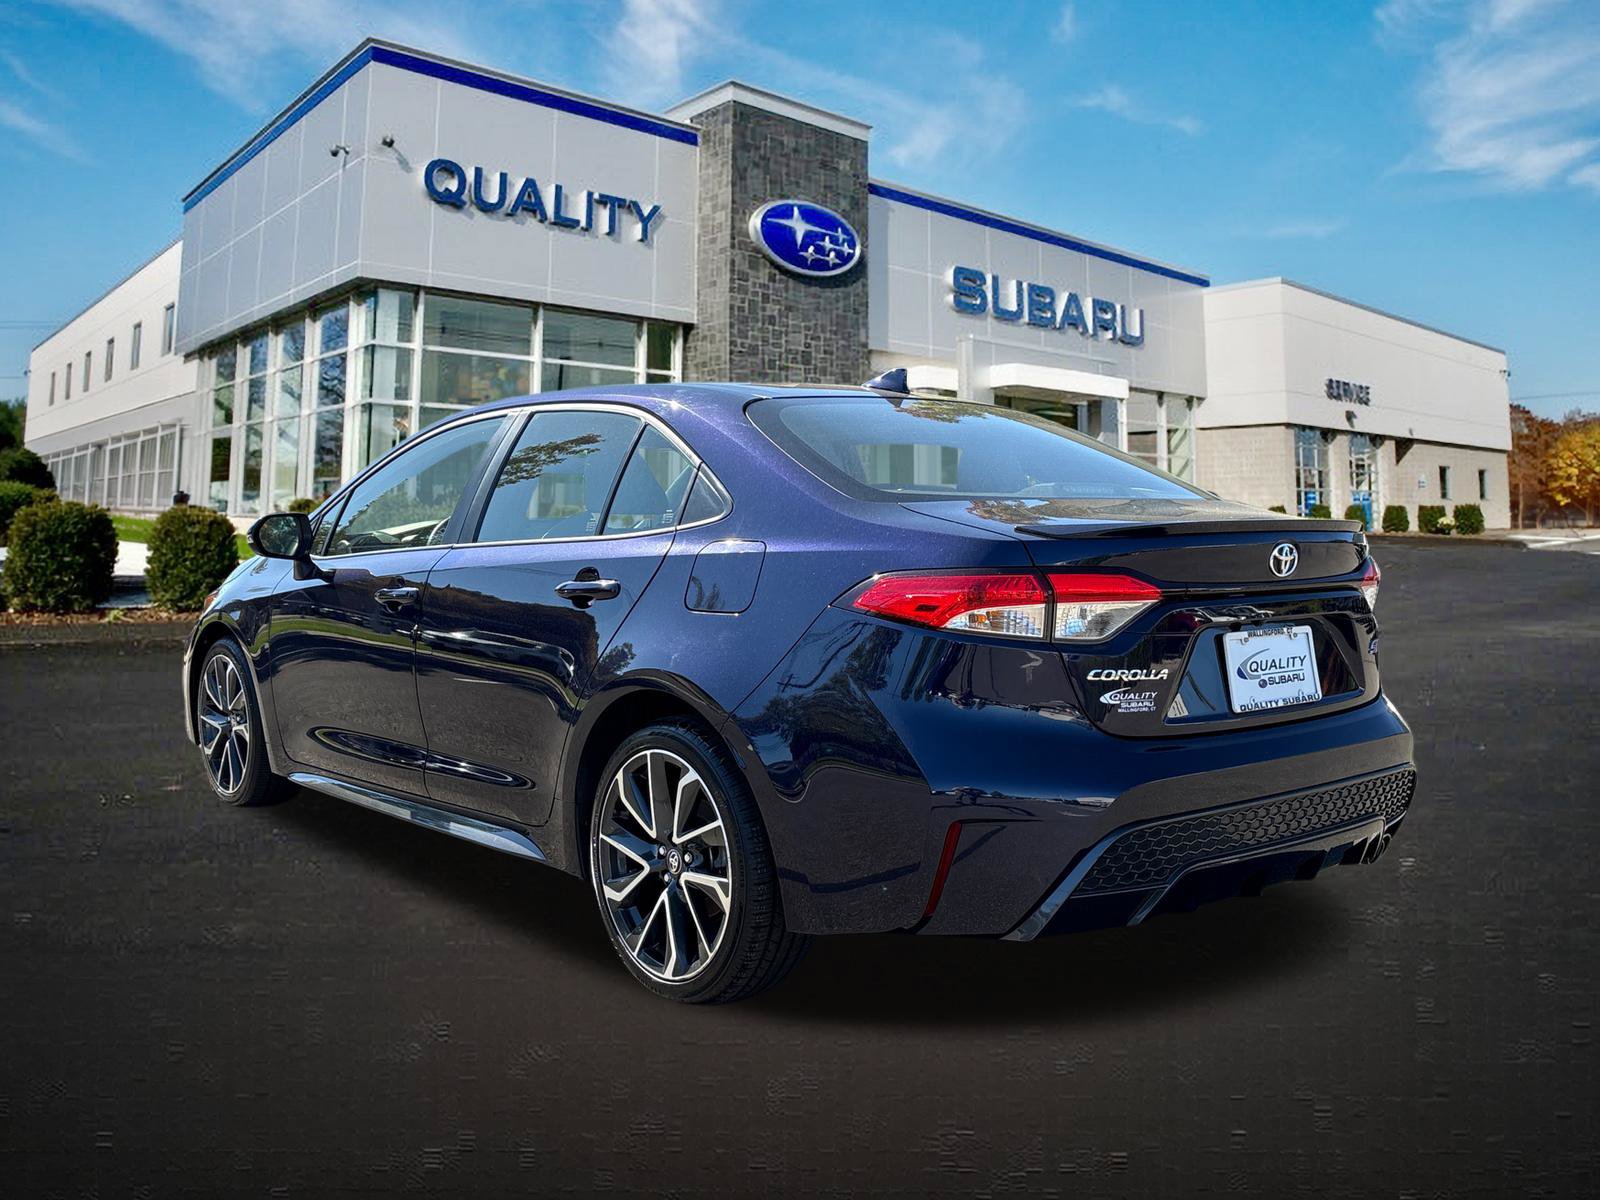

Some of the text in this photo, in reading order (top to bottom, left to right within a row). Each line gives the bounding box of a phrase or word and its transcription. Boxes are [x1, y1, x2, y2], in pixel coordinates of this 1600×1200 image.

[424, 158, 662, 243] QUALITY
[950, 265, 1145, 346] SUBARU
[1249, 655, 1306, 672] QUALITY
[1086, 668, 1169, 681] COROLLA
[1268, 673, 1305, 686] SUBARU
[1111, 692, 1157, 700] QUALITY
[1240, 693, 1320, 711] QUALITY SUBARU
